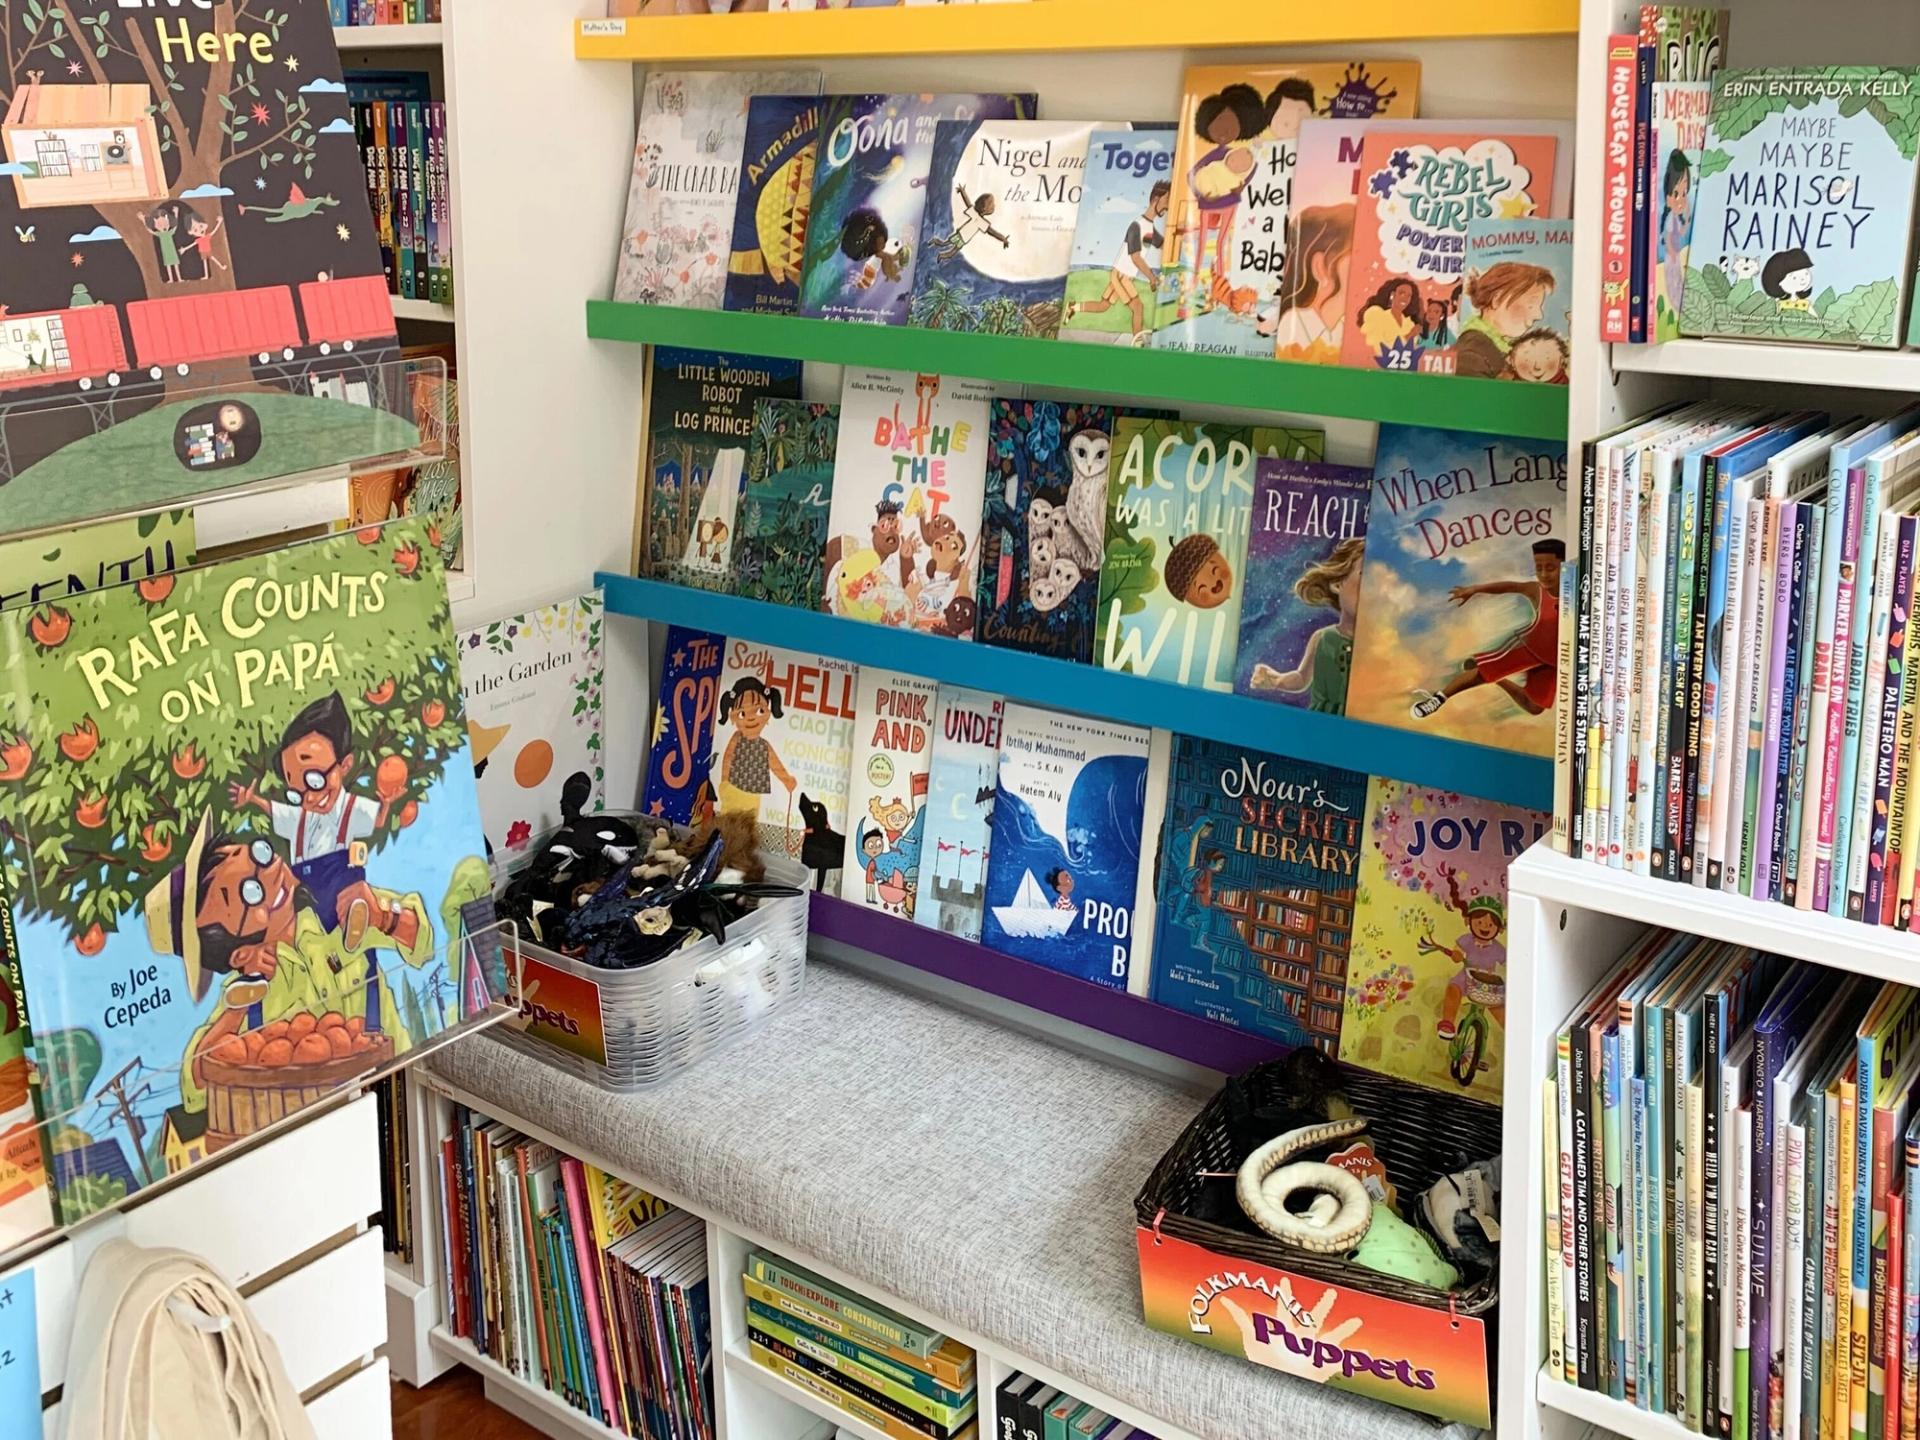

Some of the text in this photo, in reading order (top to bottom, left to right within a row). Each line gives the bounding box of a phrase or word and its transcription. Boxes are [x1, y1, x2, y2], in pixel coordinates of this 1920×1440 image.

[155, 16, 274, 64] Here
[1724, 80, 1913, 97] ERIN ENTRADA KELLY
[828, 113, 909, 168] Oona
[1780, 116, 1840, 139] MAYBE
[660, 165, 717, 194] THE CRAB
[978, 138, 1051, 176] Nigel
[1415, 155, 1513, 198] REBEL
[1606, 65, 1632, 256] HOUSECAT TROUBLE
[1760, 141, 1855, 171] MAYBE
[1004, 182, 1030, 202] the
[1726, 171, 1876, 211] MARISOL
[1262, 214, 1274, 233] a
[1471, 232, 1541, 251] MOMMY,
[1722, 208, 1872, 252] RAINEY
[678, 362, 771, 388] LITTLE WOODEN
[1387, 350, 1413, 370] 25
[702, 384, 743, 404] ROBOT
[674, 410, 700, 430] LOG
[874, 416, 972, 456] BATHE
[892, 454, 946, 487] THE
[1376, 466, 1479, 517] When
[882, 482, 951, 518] CAT
[1115, 493, 1203, 531] WAS A
[1263, 488, 1361, 541] REACH
[1582, 465, 1595, 552] Ahmed Burrington
[1414, 507, 1552, 560] Dances
[1793, 523, 1805, 583] Charles Collier
[1778, 527, 1791, 604] BYERS BOBO
[77, 608, 209, 711] RAFA
[220, 570, 388, 640] COUNTS
[687, 638, 720, 672] THE
[727, 641, 772, 678] Say
[1591, 607, 1601, 666] ARCHITECT
[1633, 576, 1647, 695] ROSIE ENGINEER
[1830, 588, 1852, 704] PARKER SHINES ON
[160, 630, 341, 724] ON PAPÁ
[474, 650, 573, 696] the Garden
[817, 656, 849, 673] Rachel
[1575, 614, 1590, 754] MAE THE STARS
[1688, 620, 1705, 758] AM EVERY GOOD THING
[1750, 662, 1760, 713] DESIGNED
[1849, 641, 1864, 692] JABARI
[1900, 656, 1919, 707] MARTIN,
[875, 687, 933, 727] PINK,
[1049, 719, 1133, 743] THE NEW YORK TIMES
[1768, 708, 1779, 743] ENOUGH
[1845, 699, 1859, 739] TRIES
[1899, 709, 1914, 739] AND
[870, 719, 927, 754] AND
[1005, 735, 1087, 762] Ibtihaj Muhammad
[1558, 709, 1569, 765] POSTMAN
[1778, 737, 1790, 775] MATTER
[1877, 686, 1900, 788] PALETERO MAN
[1897, 742, 1912, 765] THE
[1019, 783, 1063, 803] Hatem Aly
[1219, 757, 1350, 813] Nour's
[1667, 755, 1682, 836] BARNES JAMES
[1888, 763, 1911, 854] MOUNTAINTOP
[1239, 796, 1361, 848] SECRET
[1405, 816, 1489, 857] JOY
[1772, 802, 1783, 852] Orchard Books
[1234, 825, 1359, 876] LIBRARY
[1739, 820, 1750, 880] HENRY HOLT
[110, 962, 159, 1000] By Joe
[103, 983, 173, 1030] Cepeda
[1575, 1048, 1584, 1095] John Martz
[1755, 1039, 1765, 1154] NYONG'O HARRISON
[1592, 1139, 1605, 1223] BRIGHT STAR
[1856, 1060, 1869, 1278] ANDREA DAVIS PINKNEY BRIAN PINKNEY
[1561, 1151, 1574, 1269] GET UP, STAND UP
[1575, 1108, 1590, 1302] A CAT NAMED TIM AND OTHER STORIES
[1704, 1151, 1718, 1264] HELLO, I'M JOHNNY CASH
[1676, 1199, 1685, 1273] DRAGONBOY
[1751, 1217, 1766, 1298] SULWE
[1735, 1216, 1747, 1328] You Mouse Cookie
[1874, 1257, 1888, 1295] Bright
[842, 1306, 901, 1342] CONSTRUCTION
[1187, 1271, 1317, 1335] FOLKMANIS
[1804, 1257, 1816, 1345] CARMELA FULL OF
[1251, 1311, 1437, 1391] Puppets
[1837, 1266, 1849, 1403] LAST STOP ON MARKET STREET
[1852, 1331, 1867, 1389] SIT-IN
